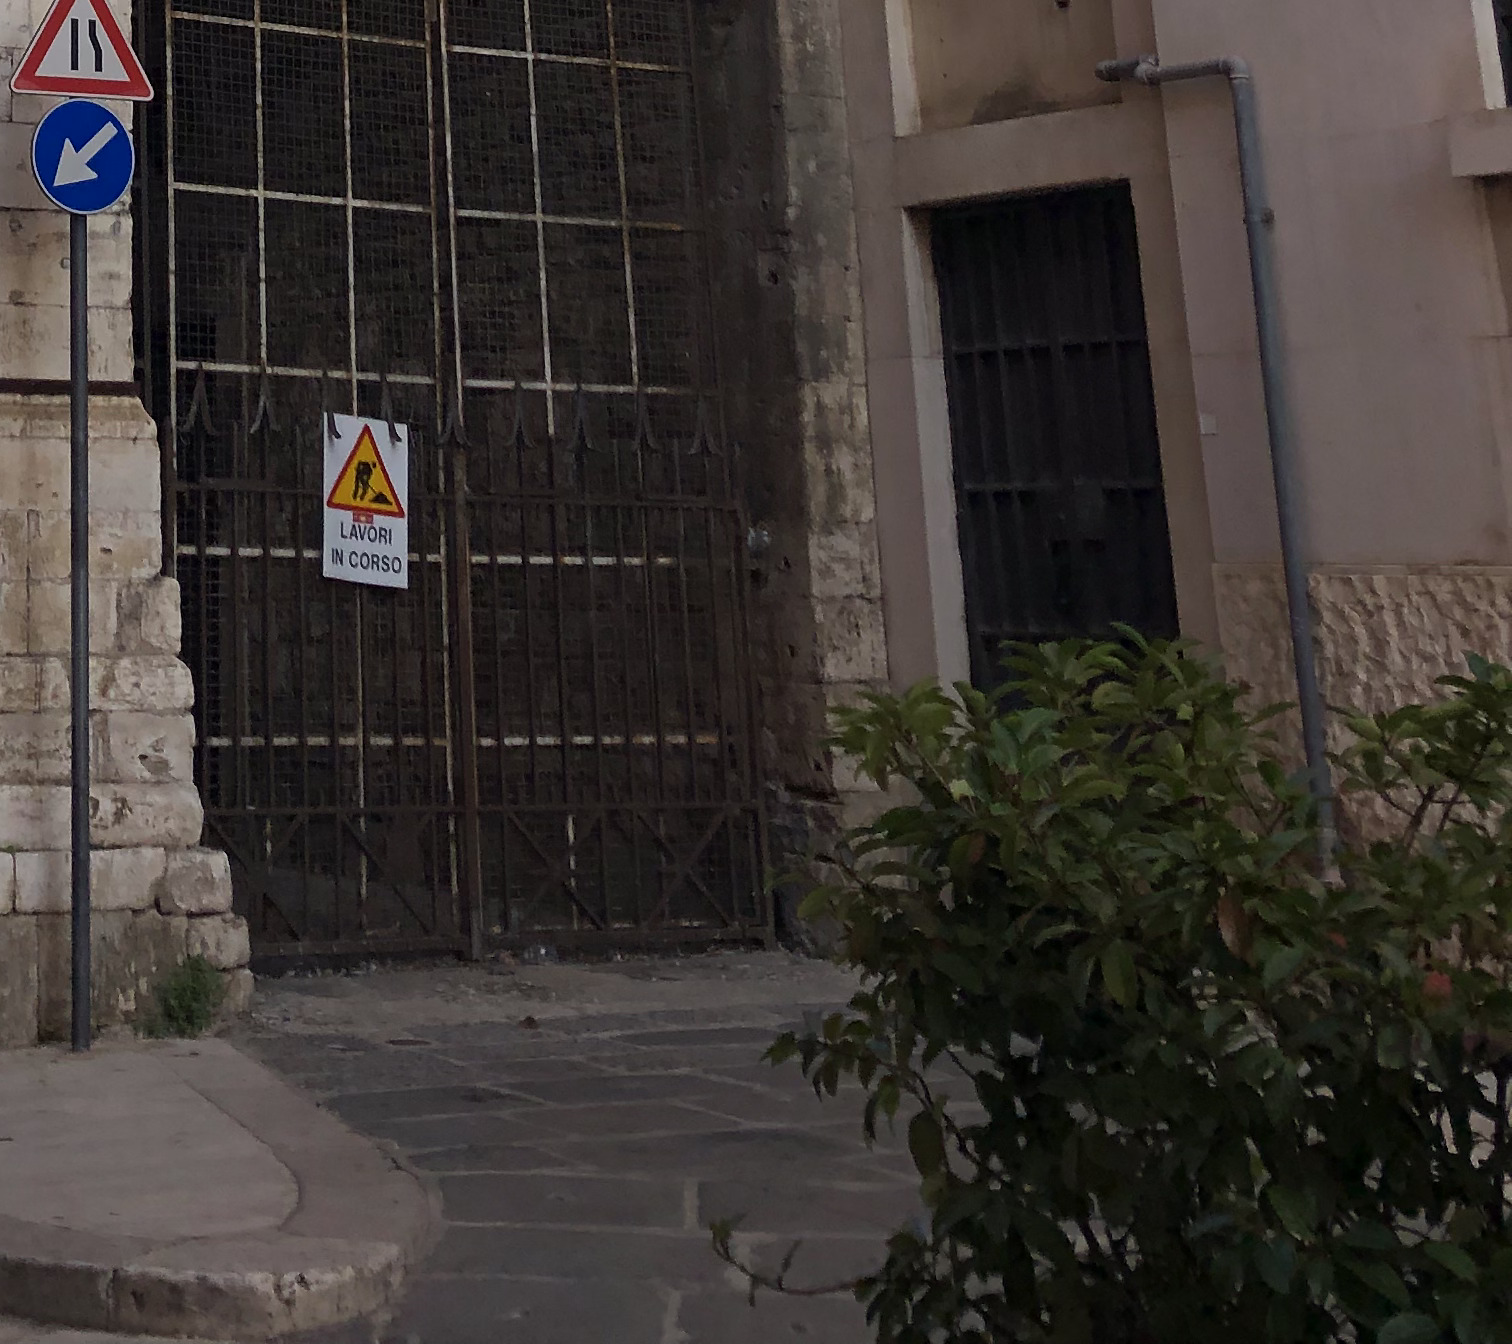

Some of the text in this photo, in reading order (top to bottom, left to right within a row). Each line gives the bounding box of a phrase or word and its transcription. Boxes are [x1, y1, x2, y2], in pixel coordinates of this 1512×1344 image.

[340, 521, 392, 546] LAVORI
[331, 547, 402, 574] IN CORSO
